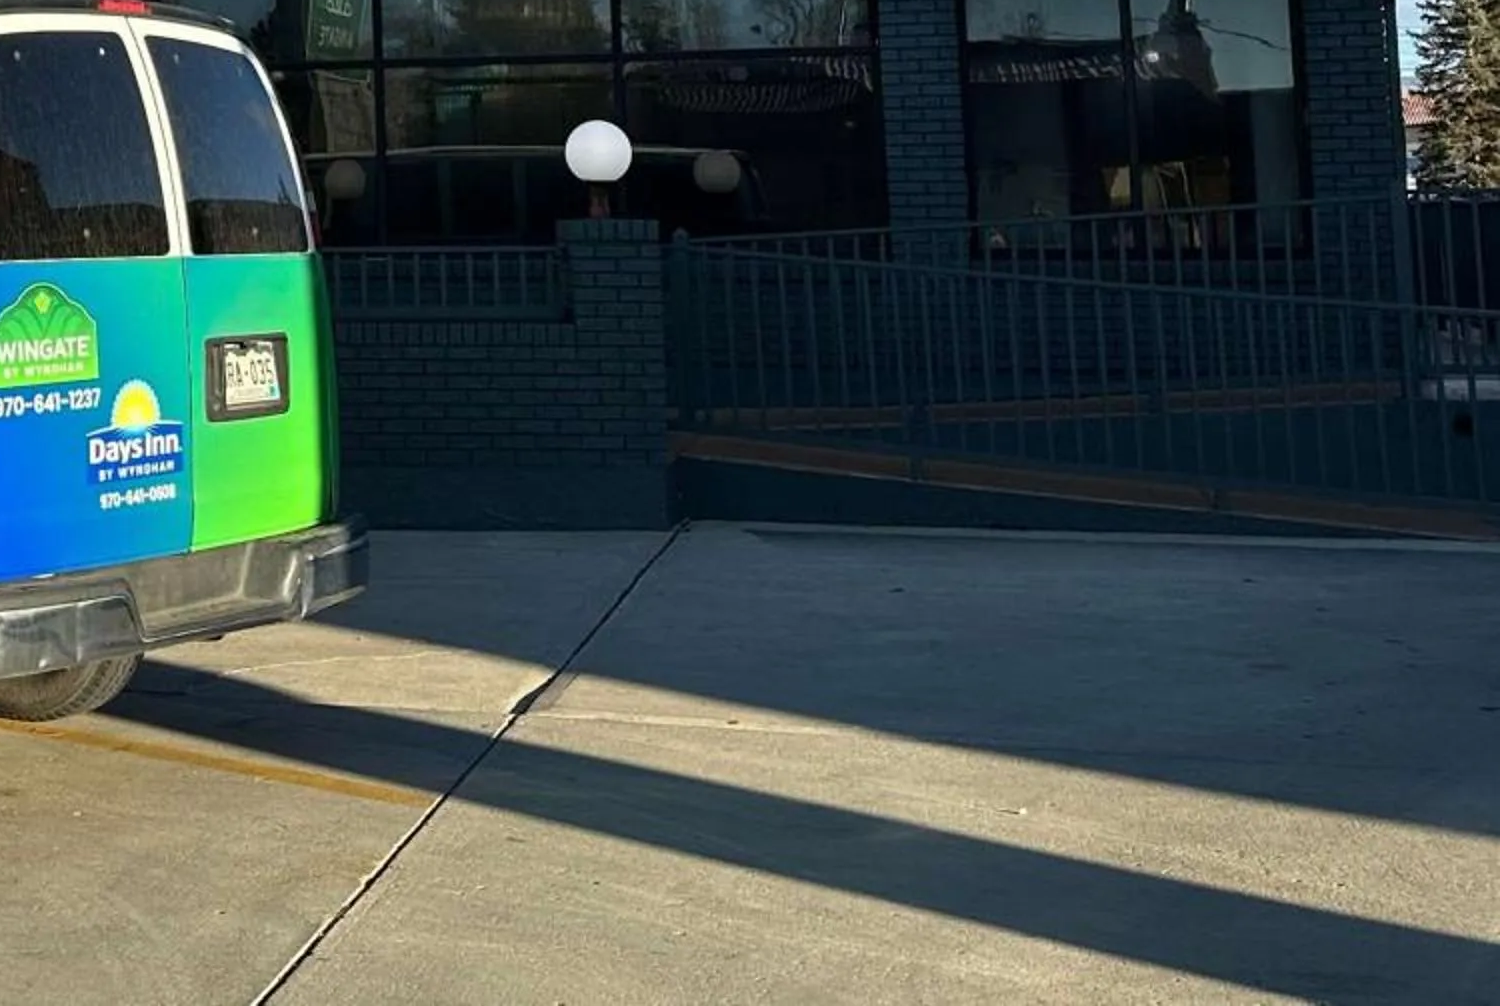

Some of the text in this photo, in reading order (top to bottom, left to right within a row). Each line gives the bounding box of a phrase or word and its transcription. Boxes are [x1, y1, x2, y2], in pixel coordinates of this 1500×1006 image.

[3, 361, 83, 380] BY WYNDHAM
[98, 462, 174, 482] BY WYNDHAM
